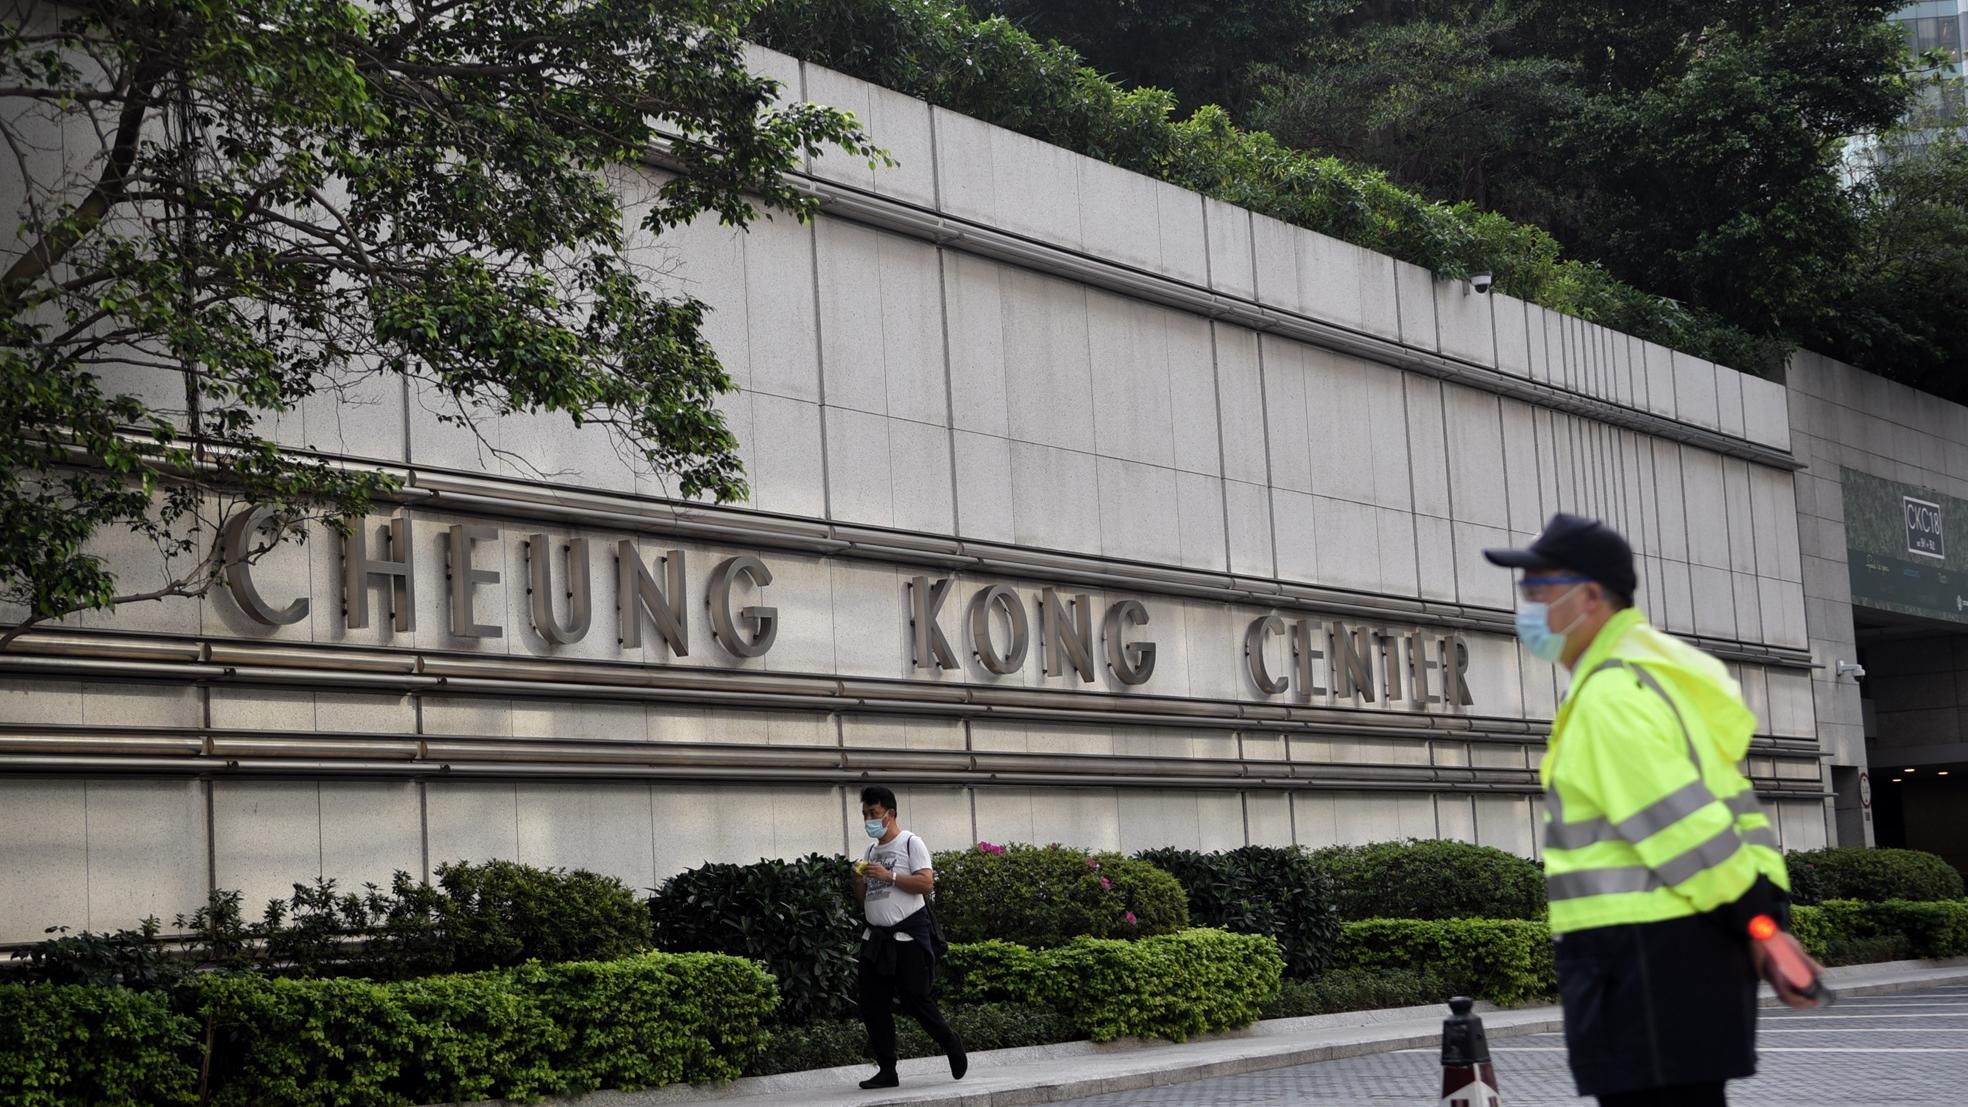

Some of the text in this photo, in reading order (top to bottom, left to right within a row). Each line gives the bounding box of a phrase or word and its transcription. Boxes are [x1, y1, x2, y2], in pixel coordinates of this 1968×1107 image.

[1907, 504, 1940, 535] CKC18
[223, 505, 1474, 706] CHEUNG KONG CENTER
